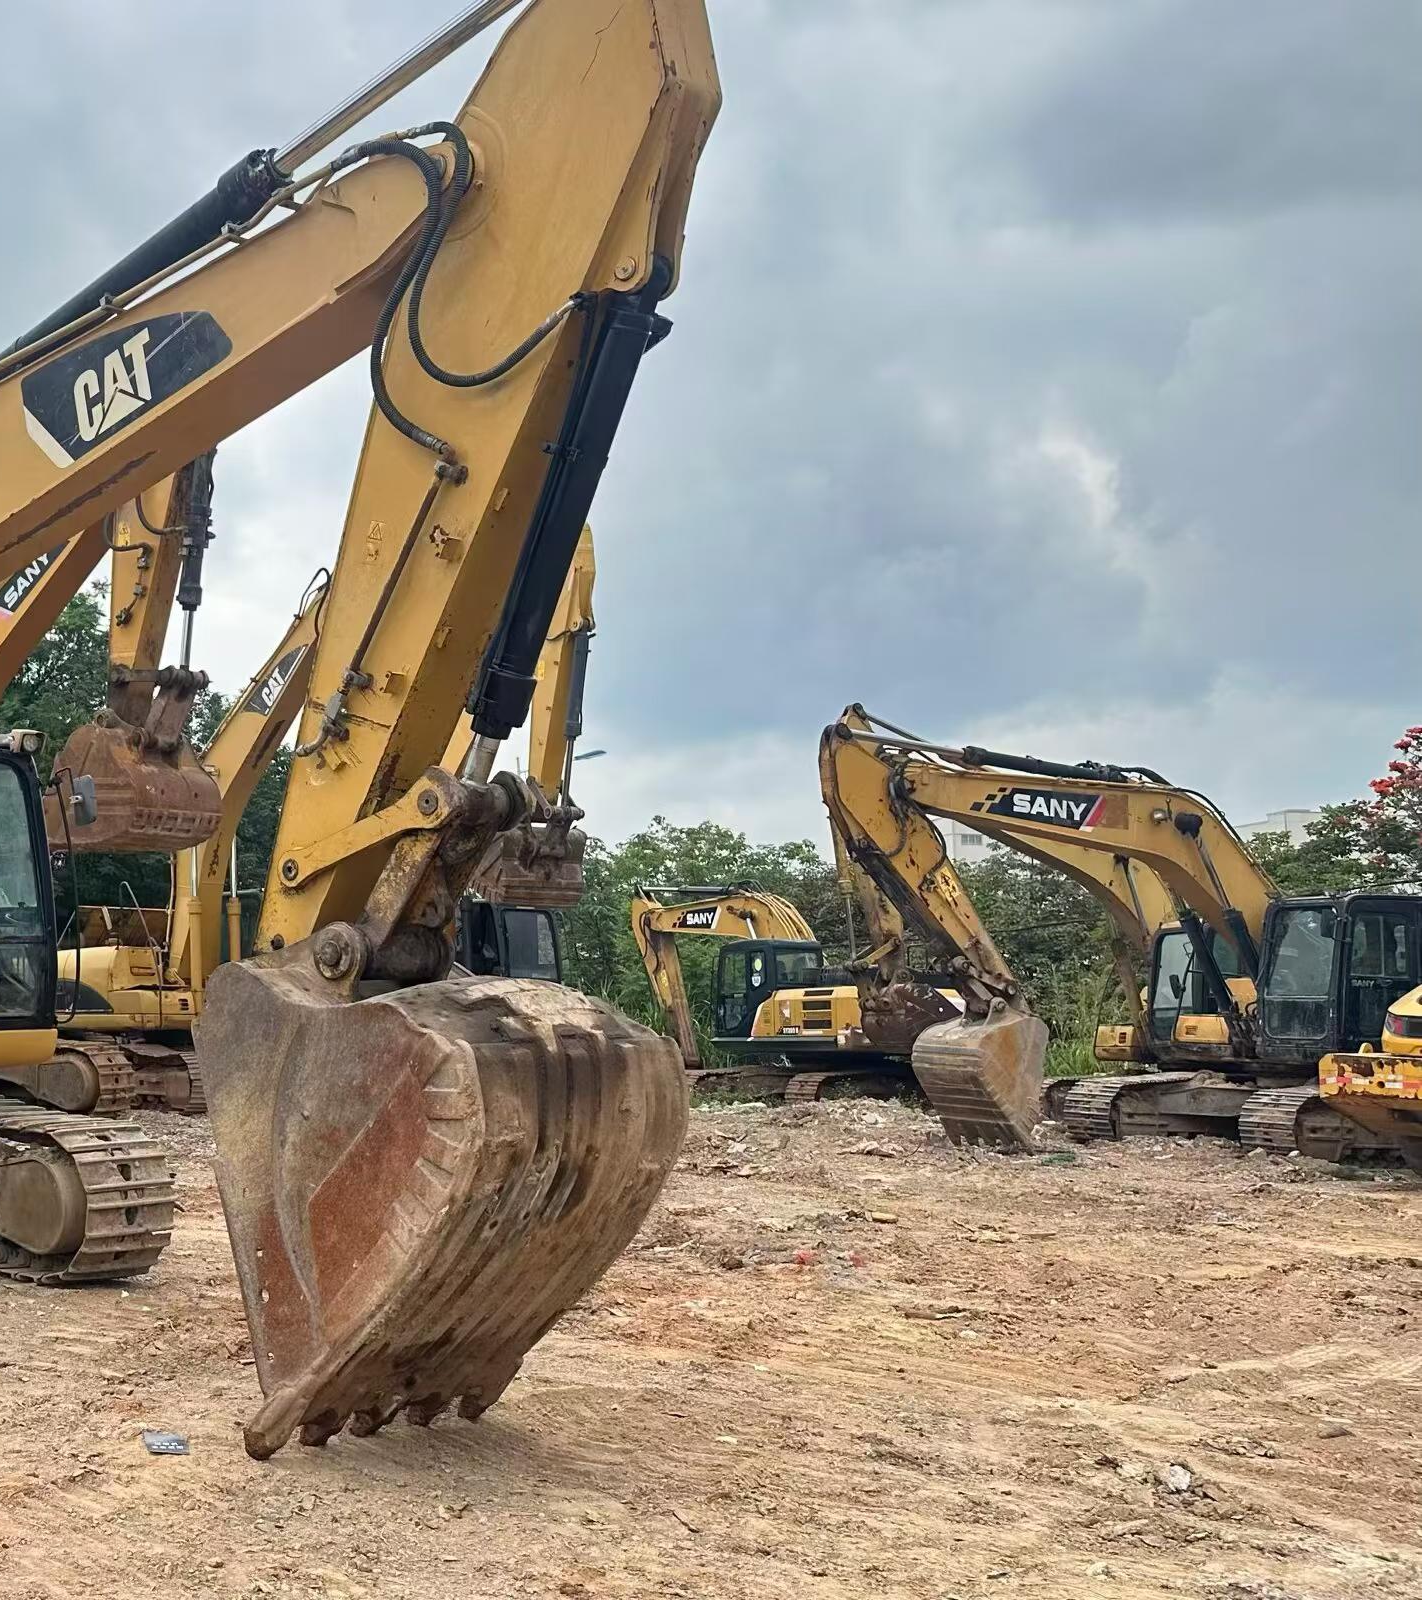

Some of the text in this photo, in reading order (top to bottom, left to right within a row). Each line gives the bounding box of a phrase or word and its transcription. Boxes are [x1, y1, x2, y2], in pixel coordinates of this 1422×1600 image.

[73, 327, 152, 442] CAT
[4, 552, 49, 609] SANY
[261, 666, 285, 707] CAT
[1012, 793, 1088, 821] SANY
[686, 912, 714, 925] SANY
[1351, 979, 1375, 988] SANY
